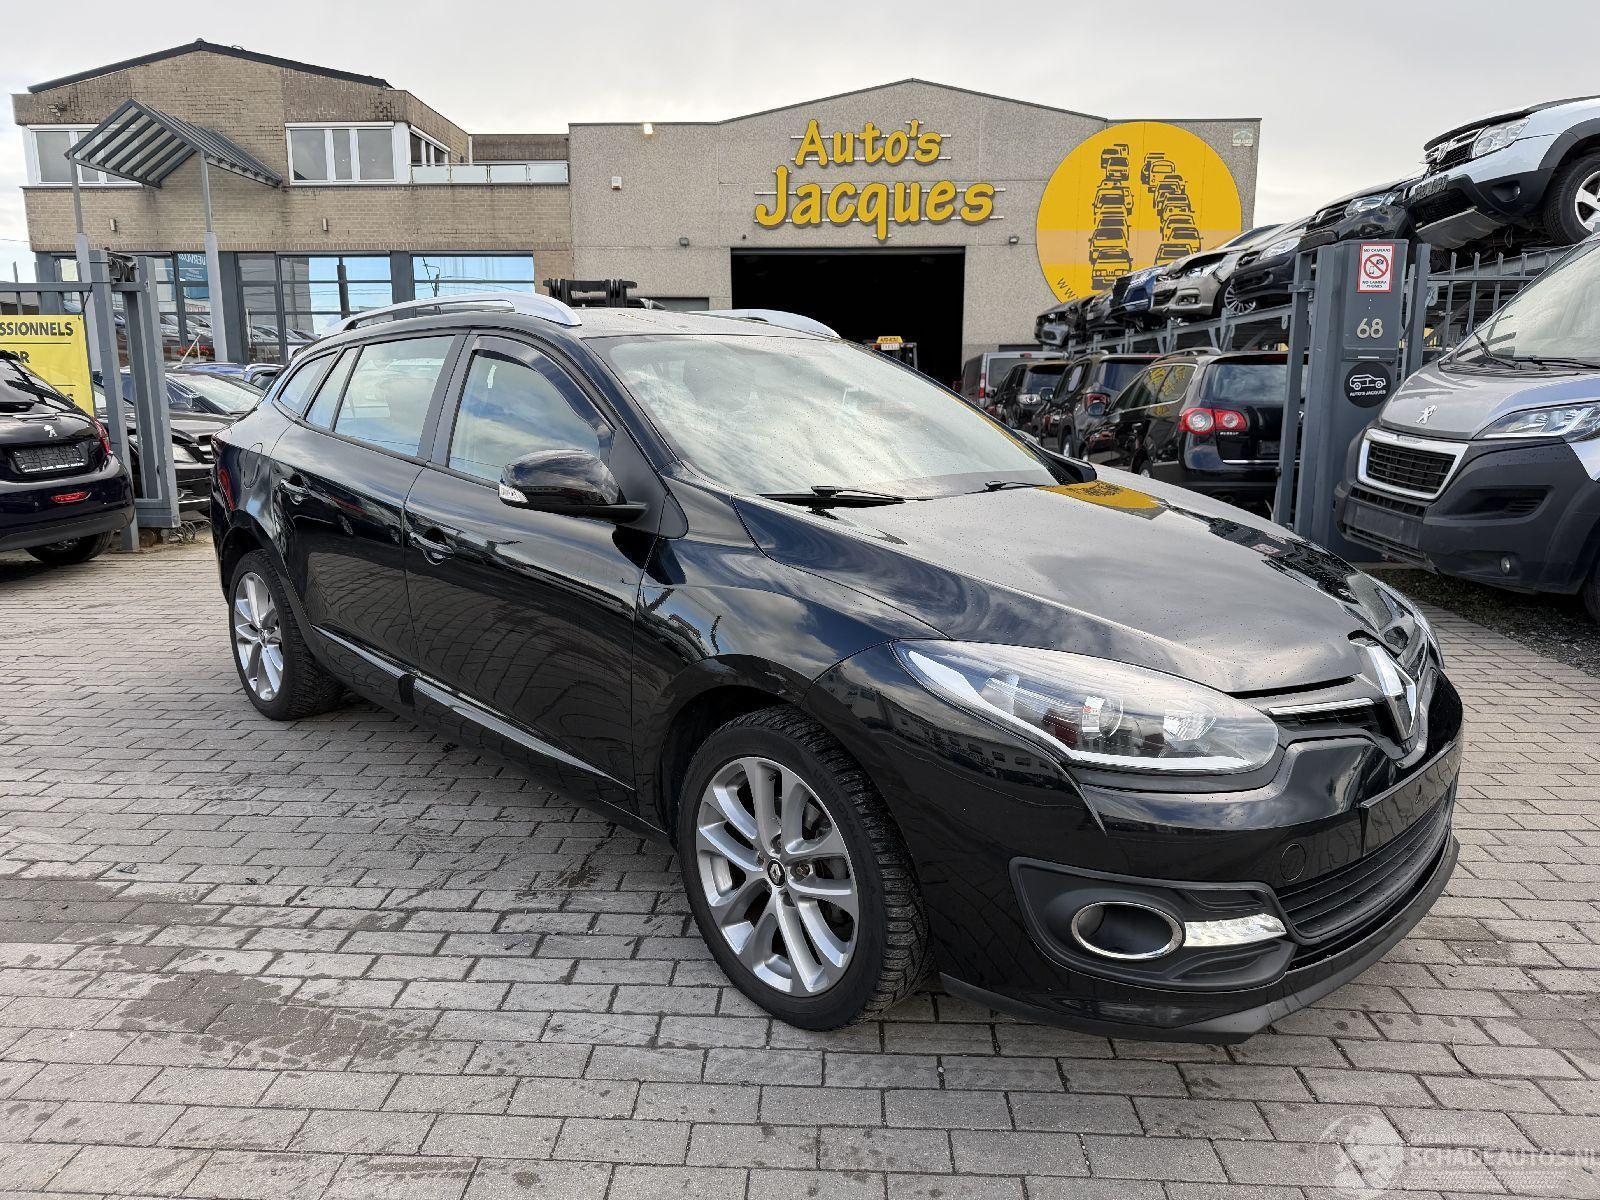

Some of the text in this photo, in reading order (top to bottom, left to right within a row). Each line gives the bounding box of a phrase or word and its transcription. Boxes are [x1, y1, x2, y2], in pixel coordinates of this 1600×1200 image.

[794, 118, 943, 167] Auto's
[755, 165, 996, 241] Jacques
[1356, 317, 1384, 339] 68
